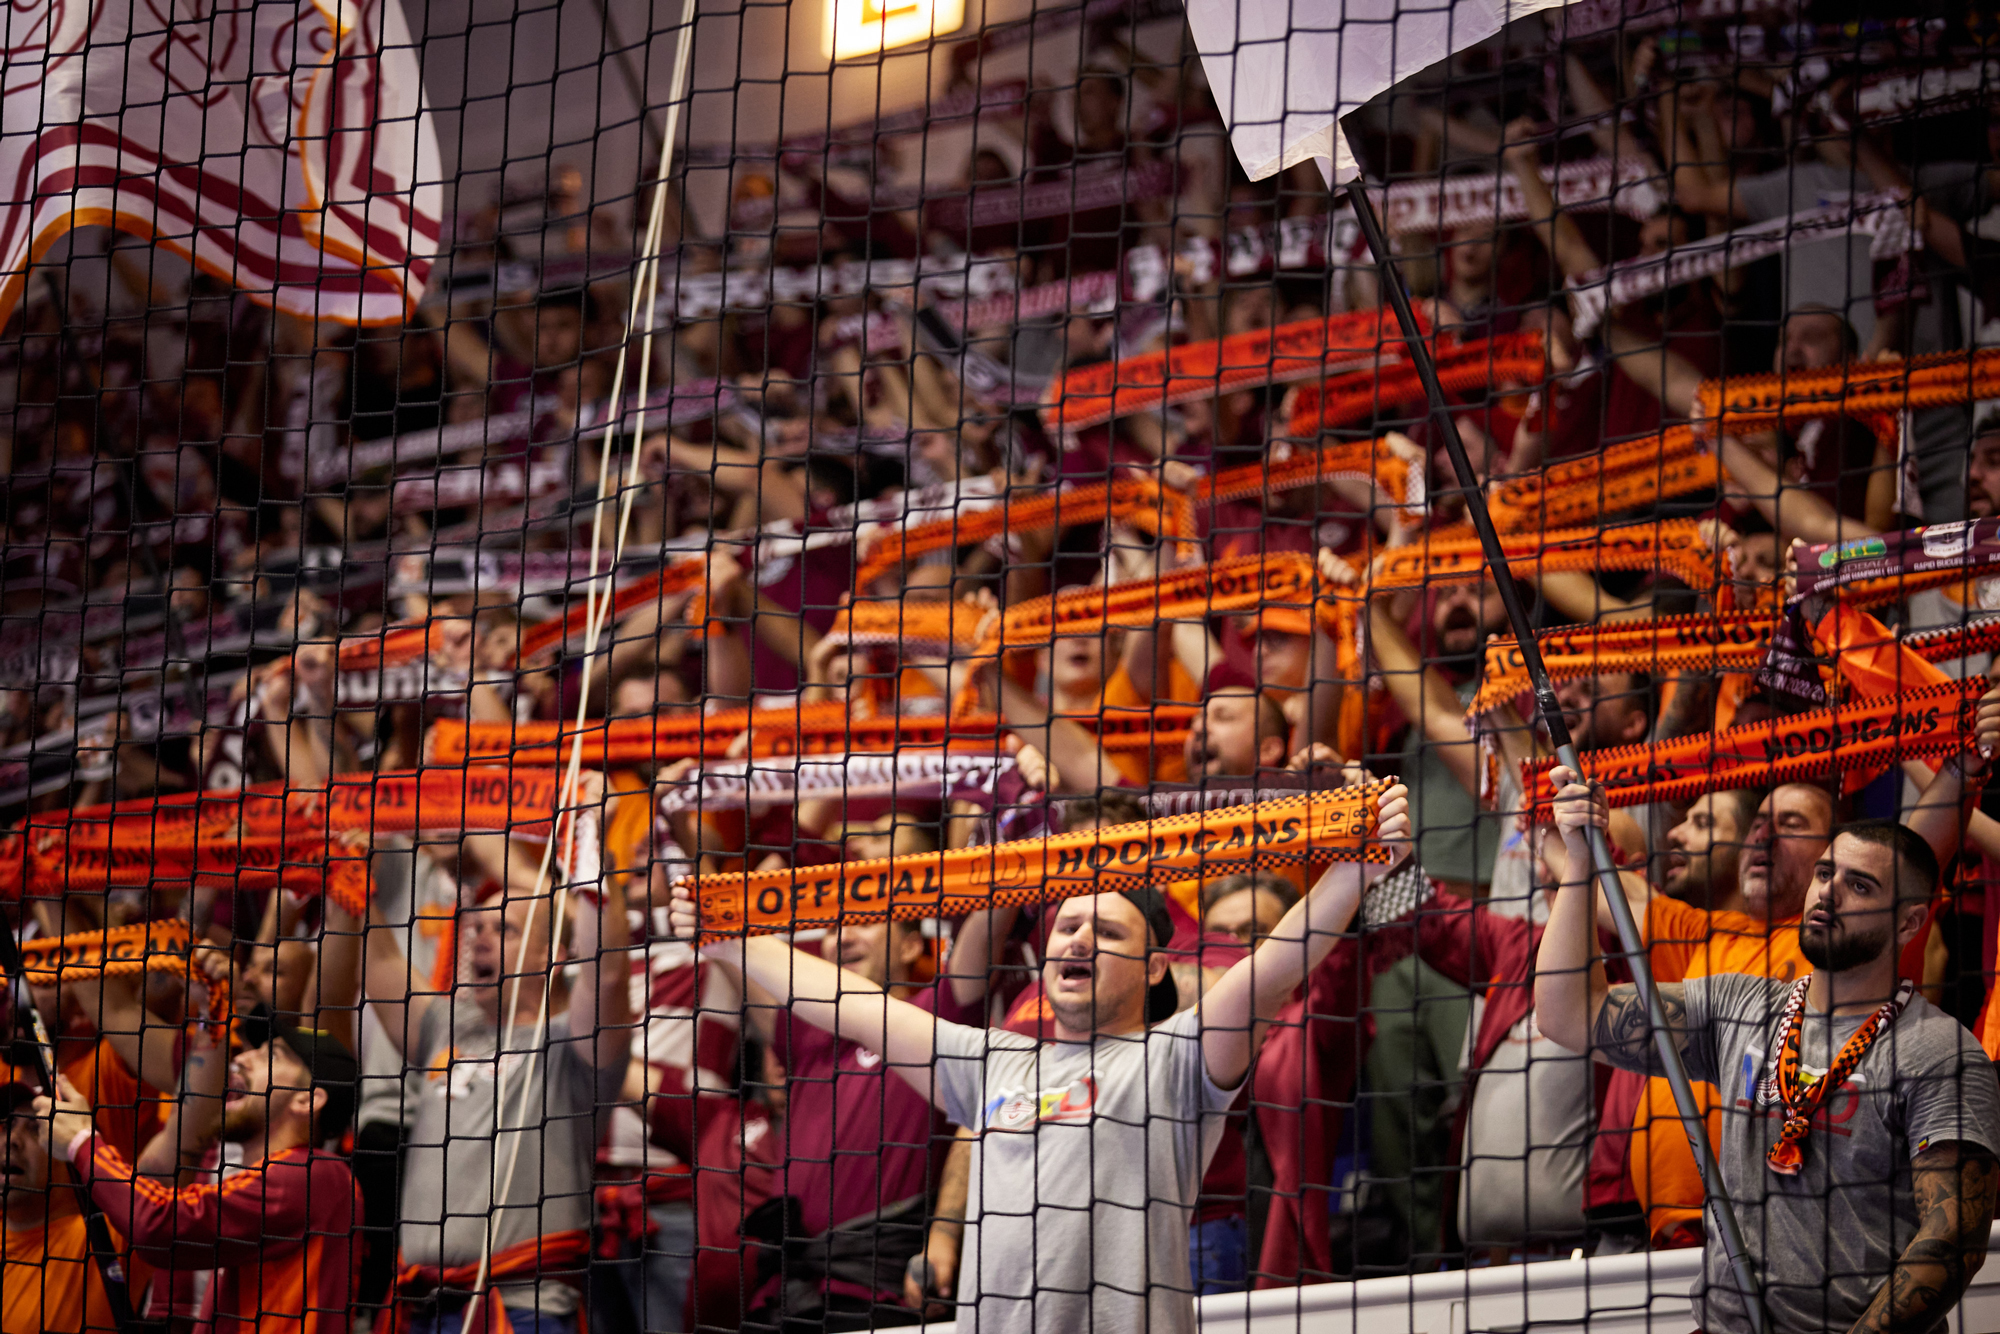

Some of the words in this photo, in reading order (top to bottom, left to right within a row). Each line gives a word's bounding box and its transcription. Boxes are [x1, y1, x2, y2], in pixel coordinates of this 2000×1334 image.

[770, 728, 940, 755] OFFCIAL
[1760, 706, 1940, 763] HOOLIGANS
[469, 777, 560, 812] HOOLI
[756, 864, 942, 916] OFFICIAL
[1055, 816, 1302, 876] HOOLIGANS
